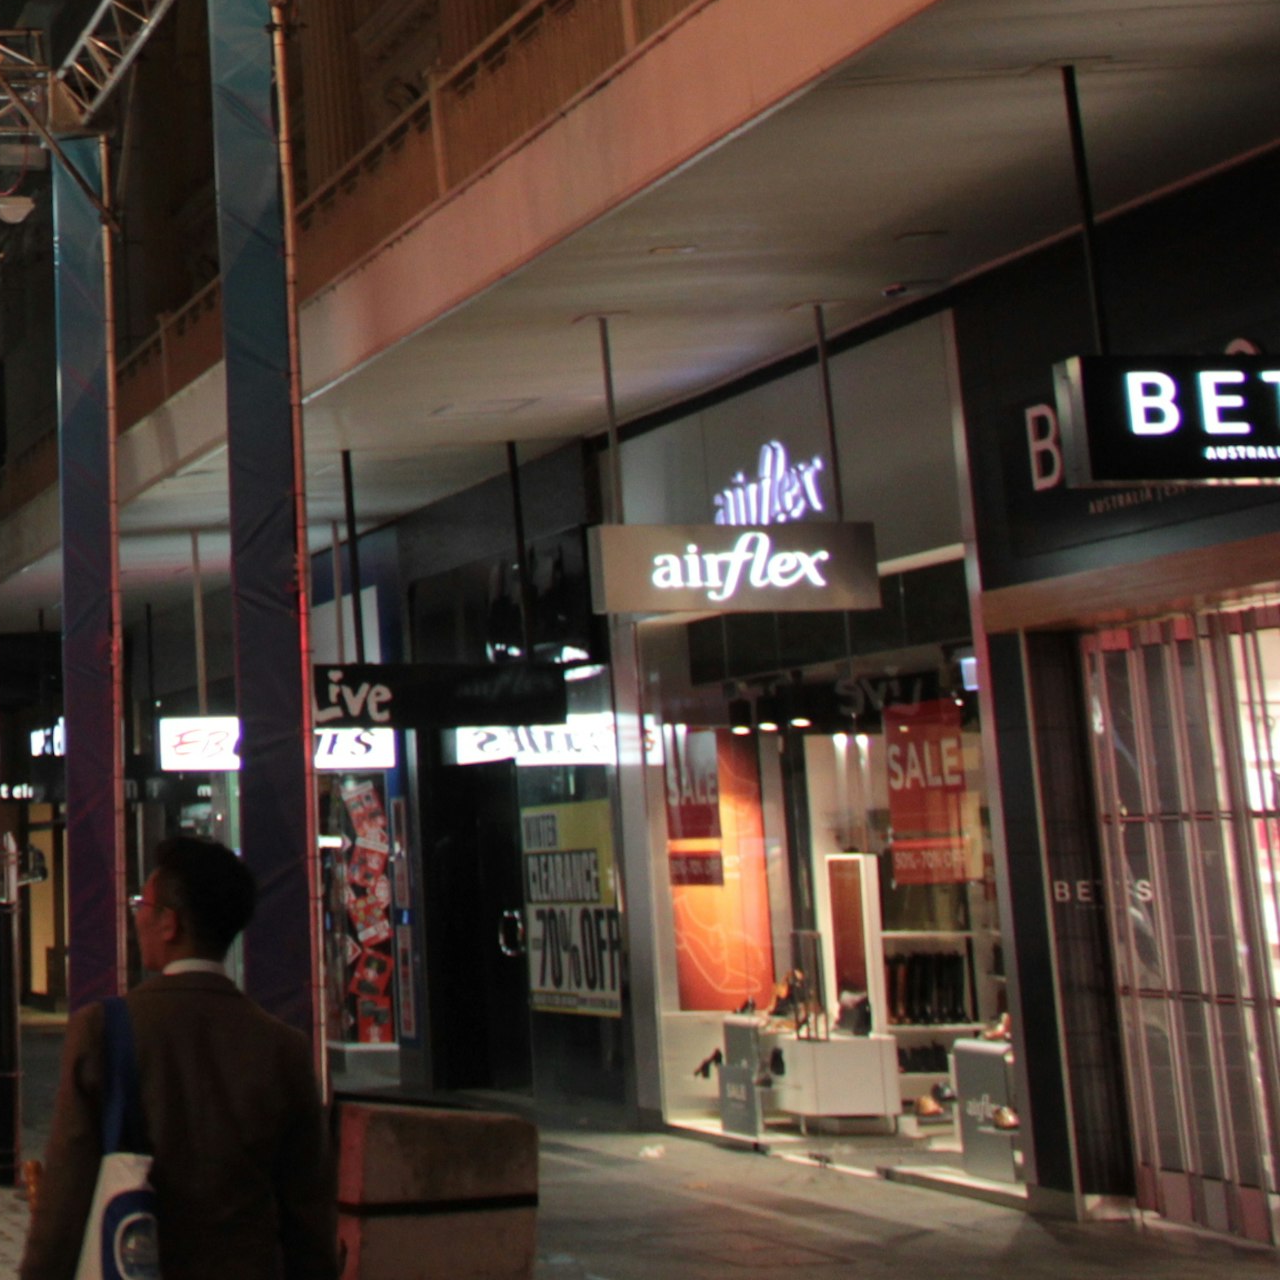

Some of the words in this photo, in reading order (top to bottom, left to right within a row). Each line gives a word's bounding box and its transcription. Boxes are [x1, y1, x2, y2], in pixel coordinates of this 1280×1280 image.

[651, 530, 831, 602] airflex
[667, 766, 718, 807] SALE
[888, 737, 962, 791] SALE
[524, 815, 557, 849] WINTER
[527, 852, 600, 902] CLEARANCE
[1053, 880, 1153, 902] BES
[536, 907, 582, 990] 70%
[580, 907, 622, 992] OFF
